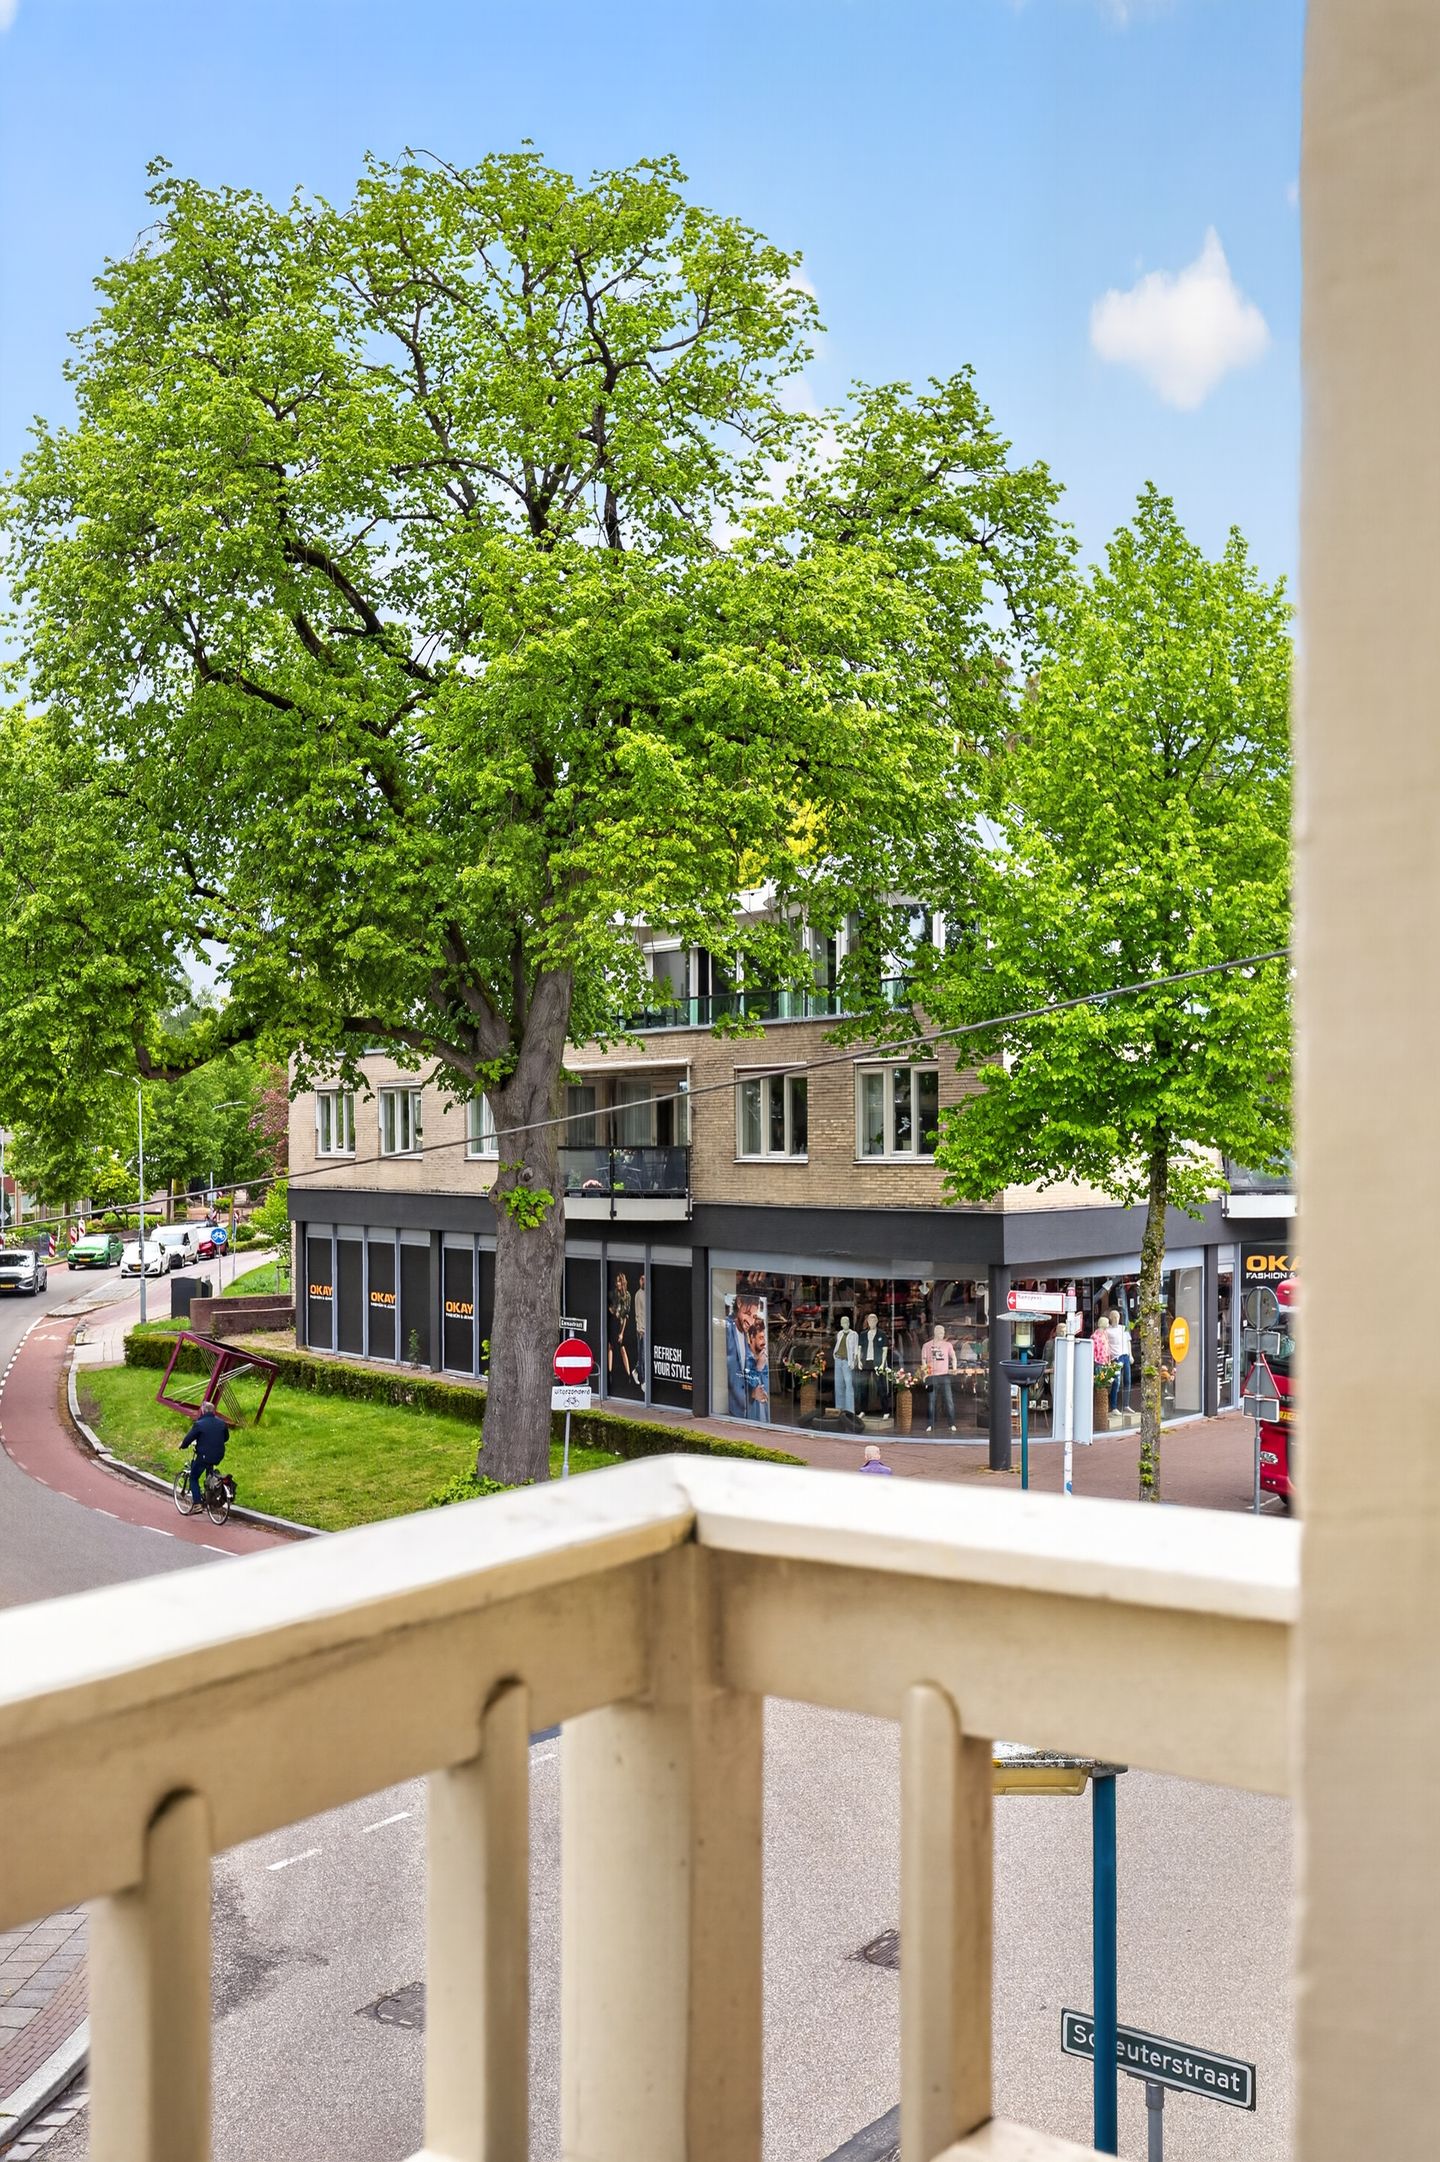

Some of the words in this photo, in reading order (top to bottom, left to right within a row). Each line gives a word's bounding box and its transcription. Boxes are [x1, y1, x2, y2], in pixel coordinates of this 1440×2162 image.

[310, 1284, 333, 1296] OKAY
[370, 1292, 396, 1304] OKAY
[445, 1301, 474, 1315] OKAY
[653, 1345, 682, 1362] REFRESH
[653, 1361, 671, 1377] YOUR
[1072, 2024, 1241, 2093] Sceuterstraat
